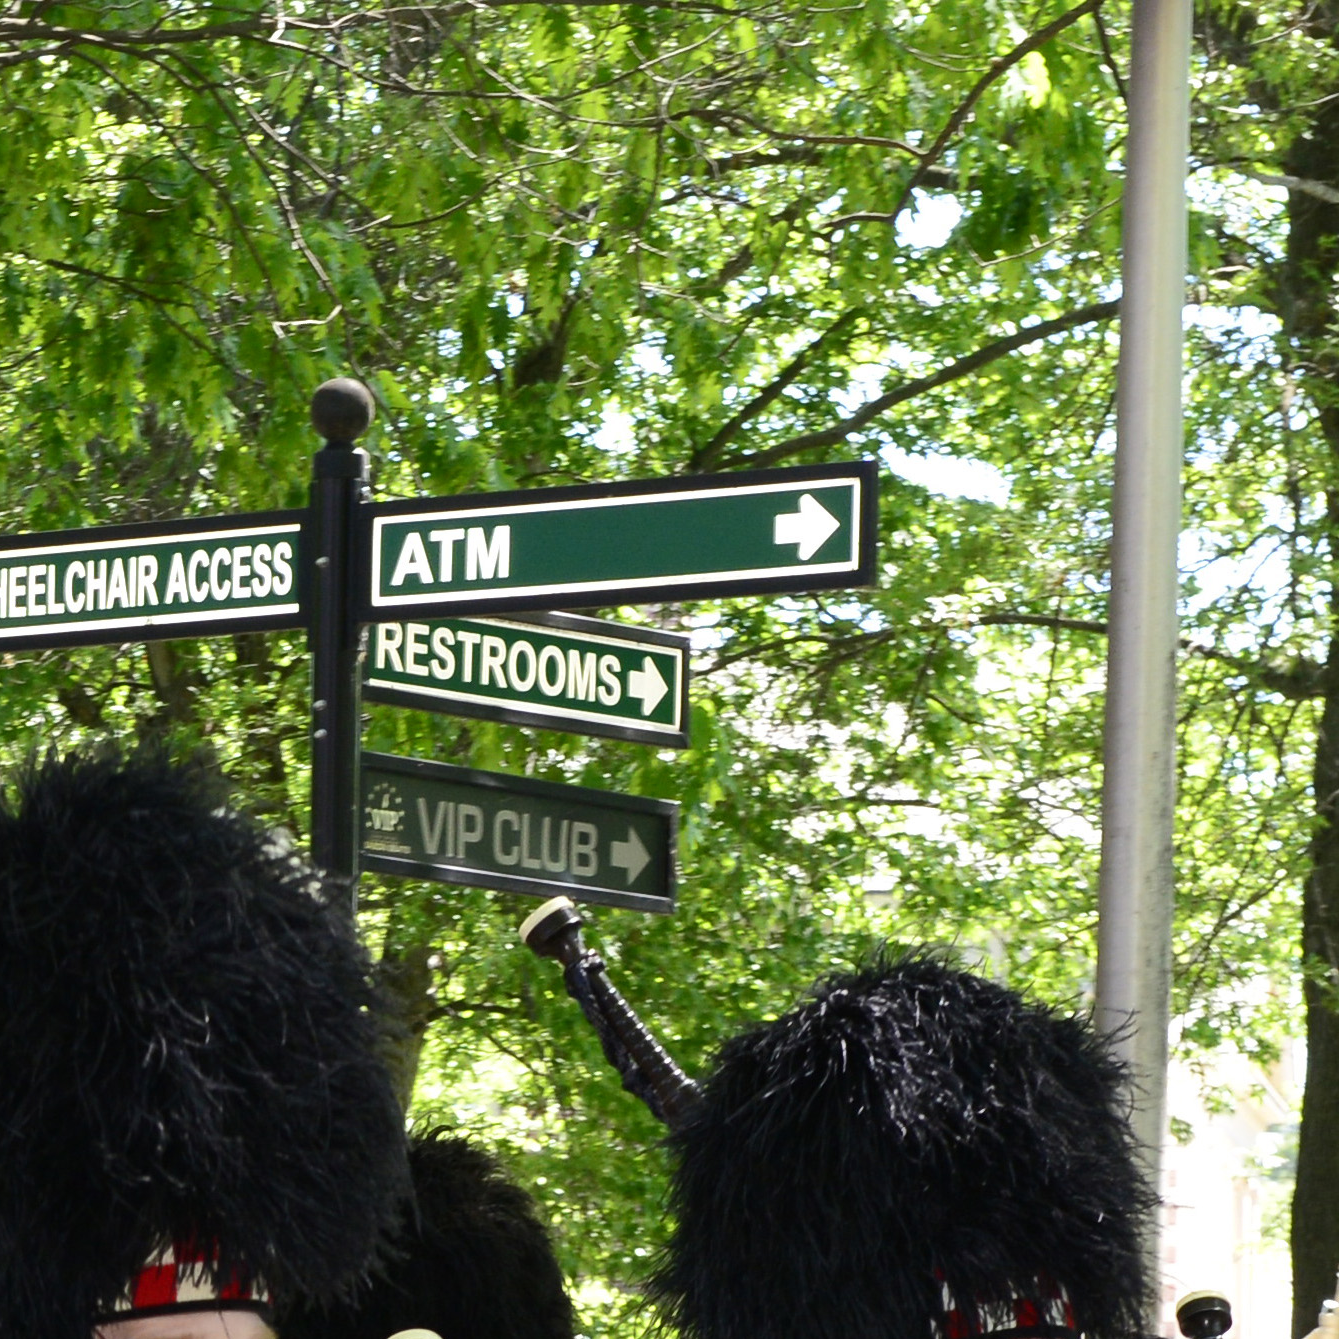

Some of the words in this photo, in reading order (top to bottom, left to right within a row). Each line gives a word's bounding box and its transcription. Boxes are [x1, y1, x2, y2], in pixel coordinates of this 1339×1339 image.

[166, 541, 294, 605] ACCESS
[389, 525, 511, 586] ATM
[375, 621, 621, 706] RESTROOMS
[417, 796, 484, 859] VIP
[493, 809, 599, 877] CLUB
